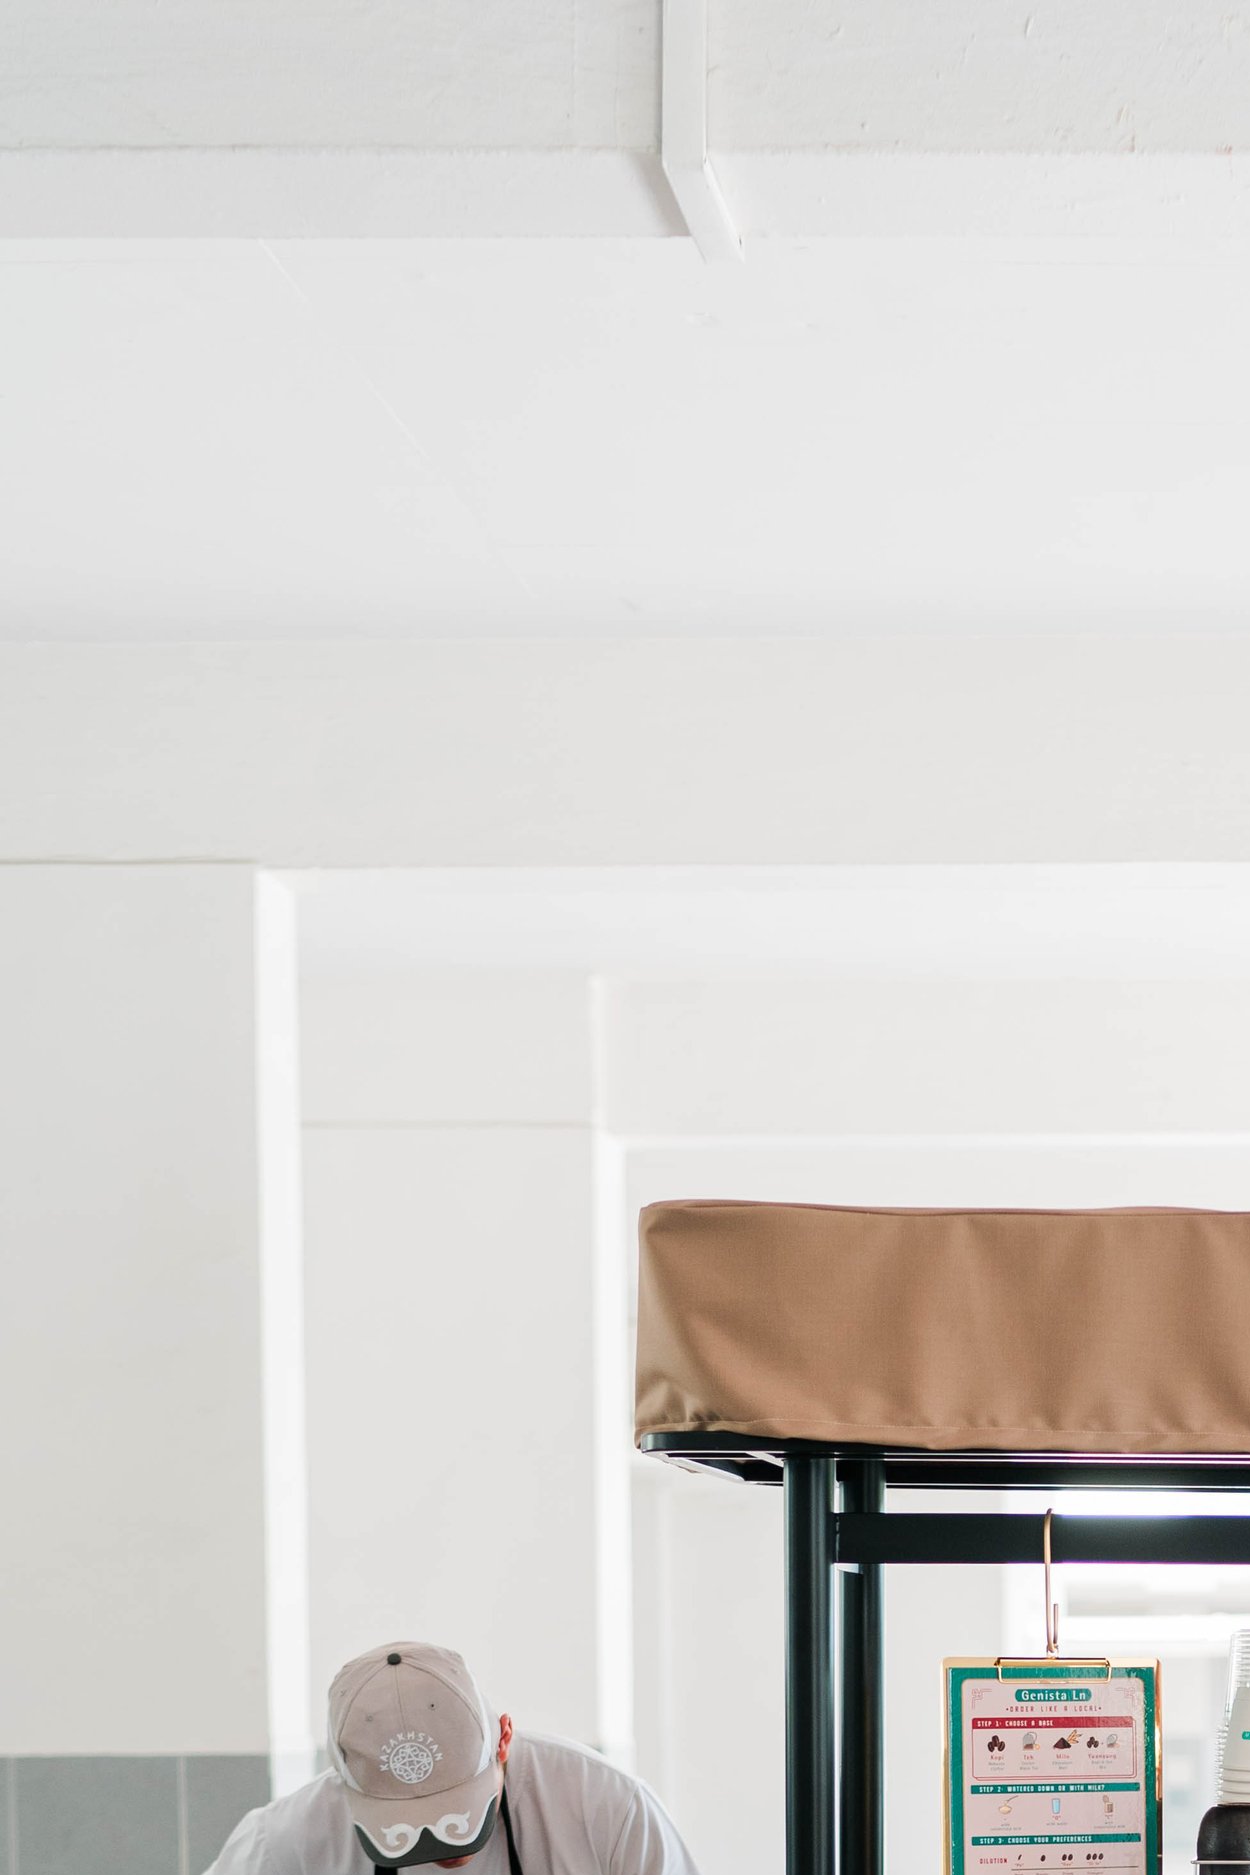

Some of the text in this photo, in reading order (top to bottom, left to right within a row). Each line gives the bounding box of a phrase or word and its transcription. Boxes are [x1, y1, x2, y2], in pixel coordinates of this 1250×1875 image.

[1021, 1690, 1087, 1701] Genista Ln
[977, 1720, 992, 1728] STEP
[1005, 1719, 1028, 1727] CHOOSE
[379, 1731, 443, 1771] KAZAKHSTAN
[979, 1837, 995, 1845] STEP
[979, 1857, 1008, 1865] DILUTION
